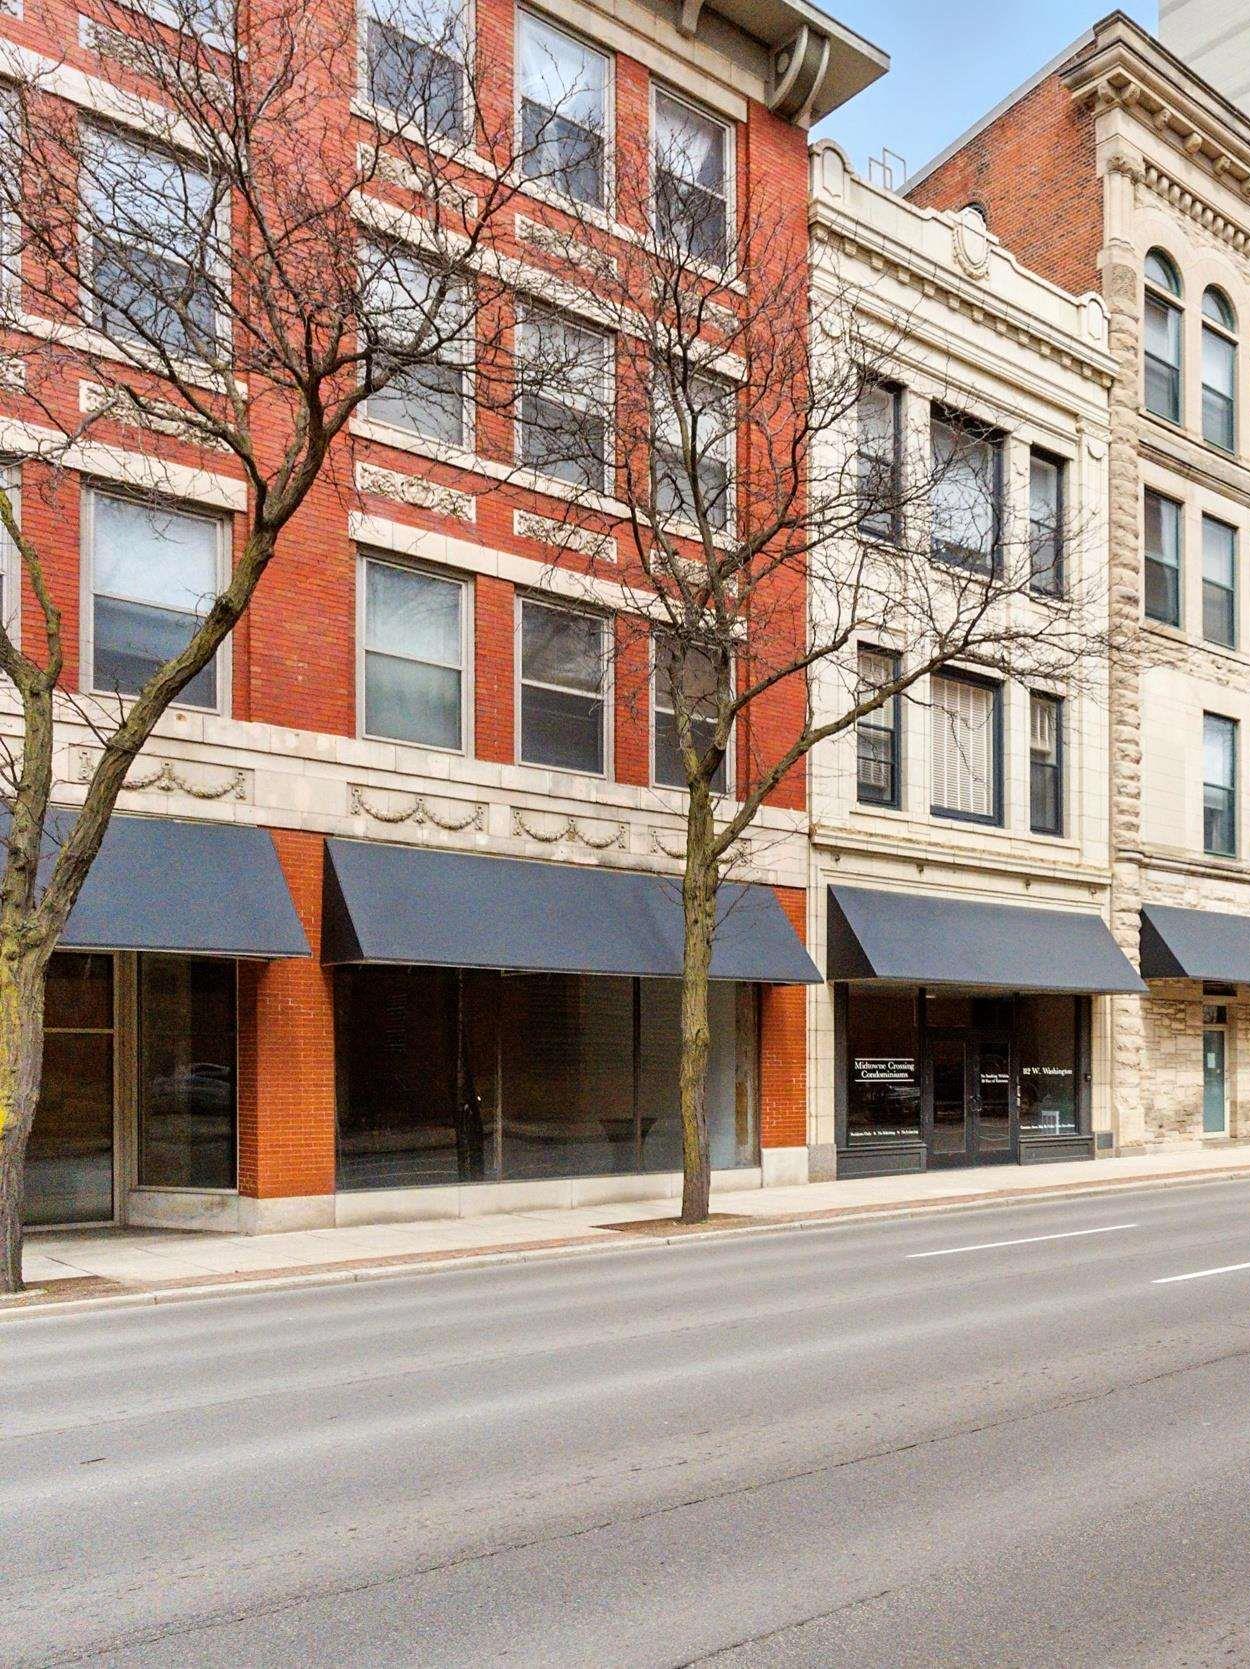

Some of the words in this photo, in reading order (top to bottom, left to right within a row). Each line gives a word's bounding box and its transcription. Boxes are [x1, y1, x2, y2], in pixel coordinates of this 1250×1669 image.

[855, 1061, 886, 1070] Midtowne
[888, 1061, 915, 1071] Crossing
[1042, 1067, 1073, 1077] Washington
